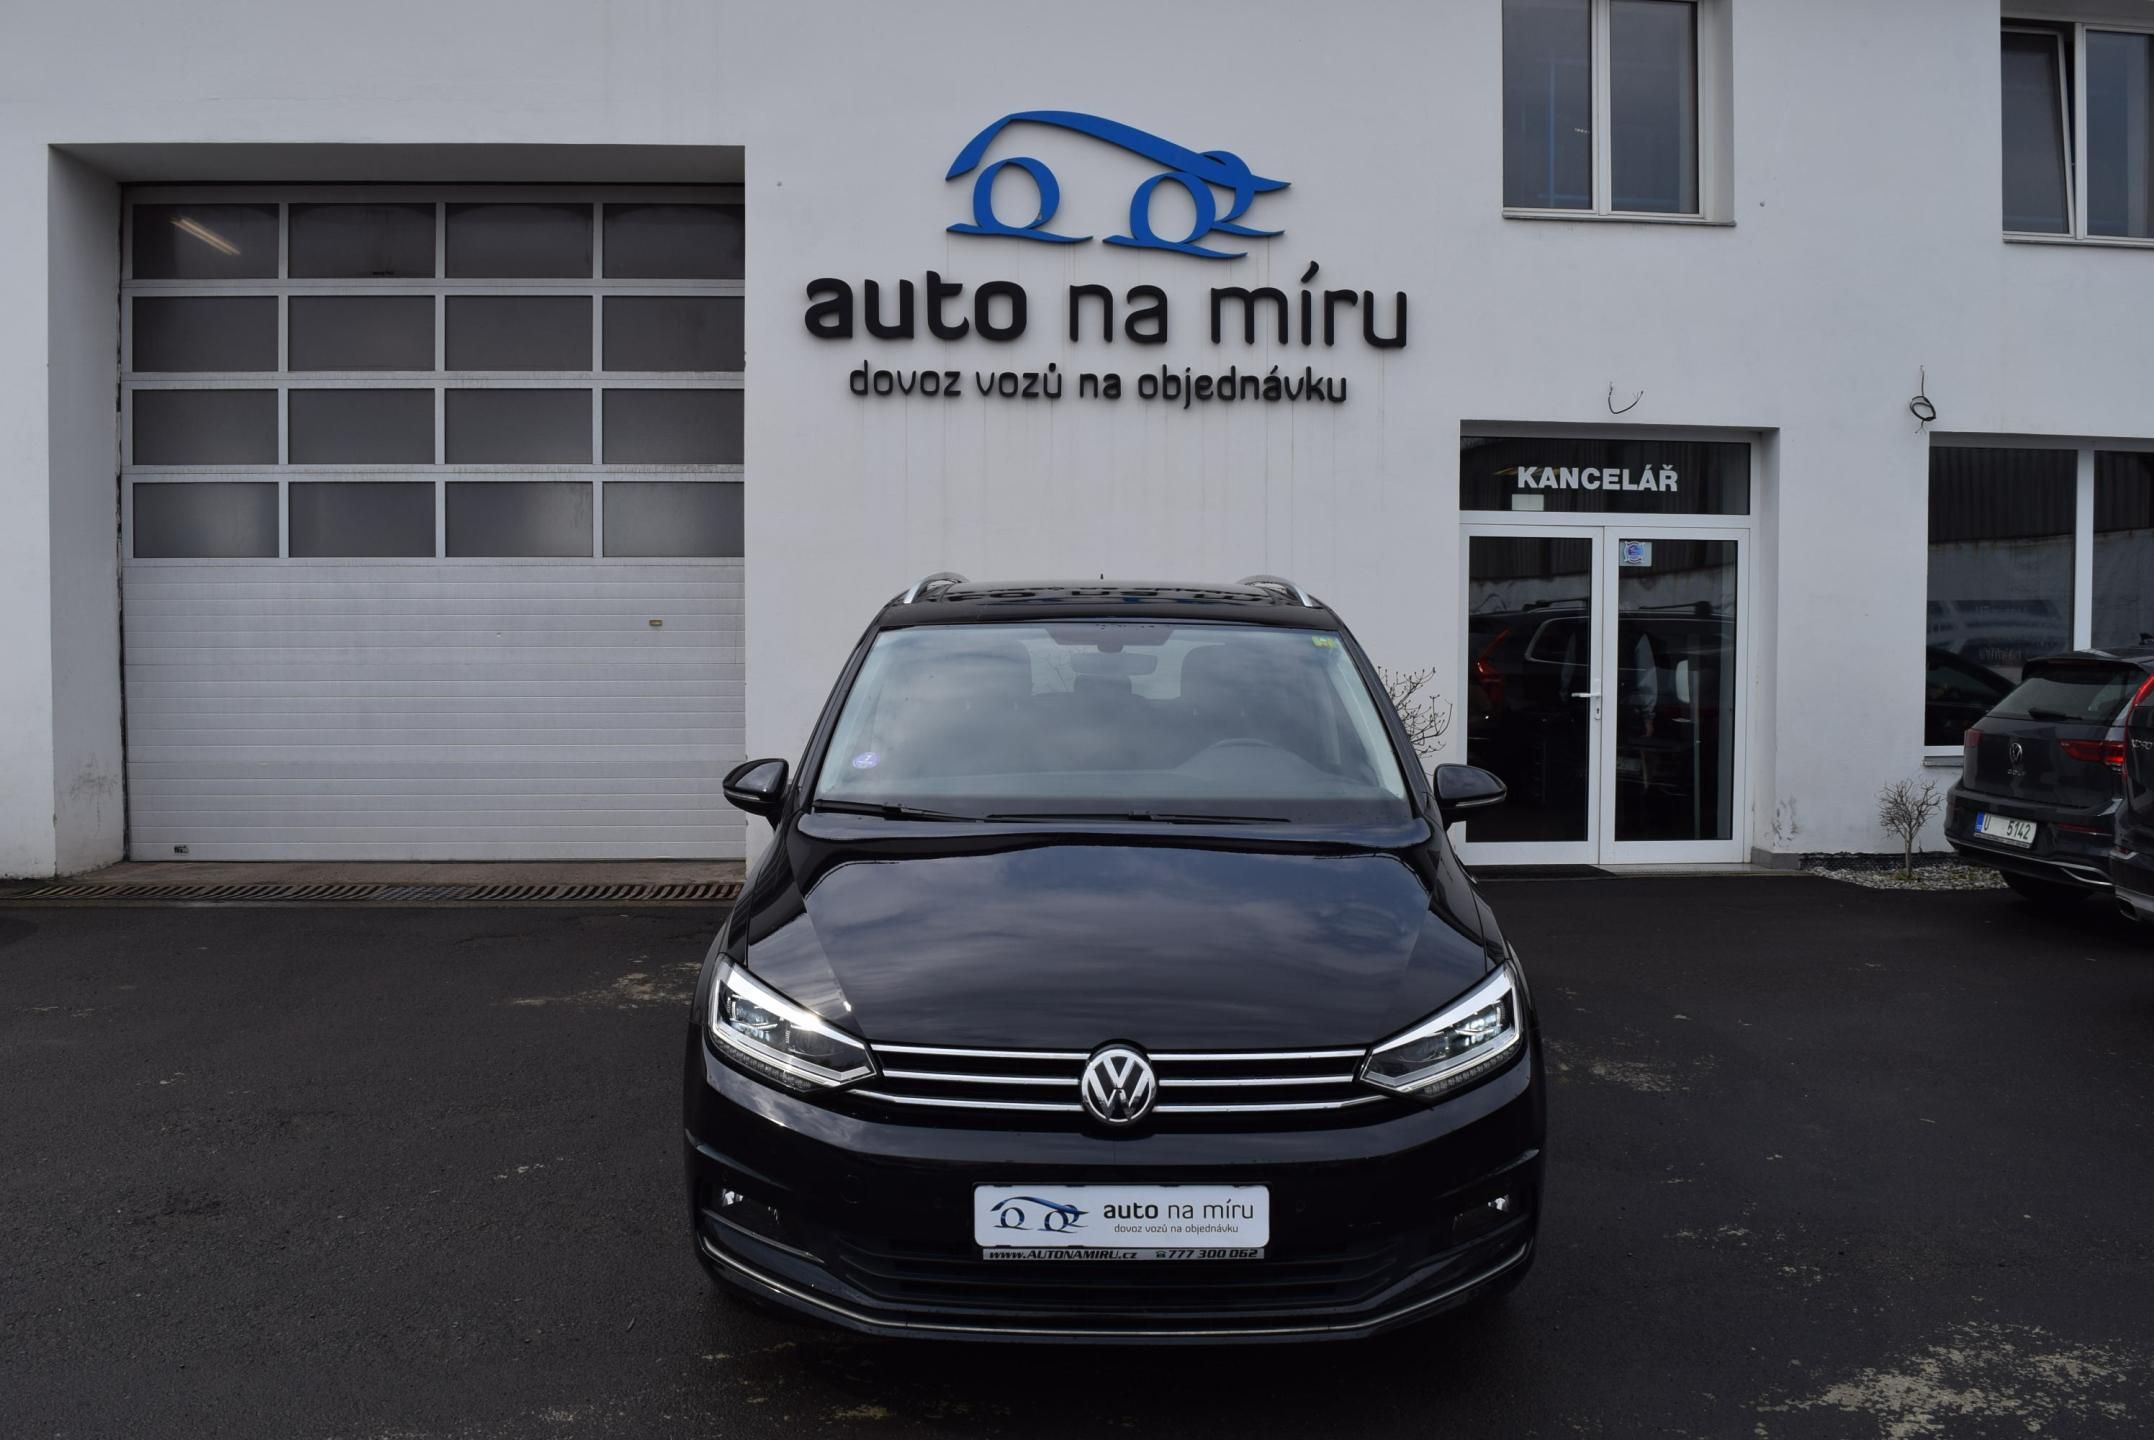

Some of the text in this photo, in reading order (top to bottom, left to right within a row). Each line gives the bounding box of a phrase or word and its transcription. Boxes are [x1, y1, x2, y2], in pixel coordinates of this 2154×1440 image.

[805, 261, 1408, 349] auto na míru
[849, 360, 1348, 409] dovoz vozů na objednávku
[1517, 464, 1678, 492] KANCELÁŘ
[1103, 1198, 1254, 1219] auto na míru
[1114, 1223, 1239, 1235] dovoz vozů na objednávku
[1168, 1249, 1197, 1259] 777
[1199, 1249, 1227, 1259] 300
[1228, 1249, 1259, 1258] 062
